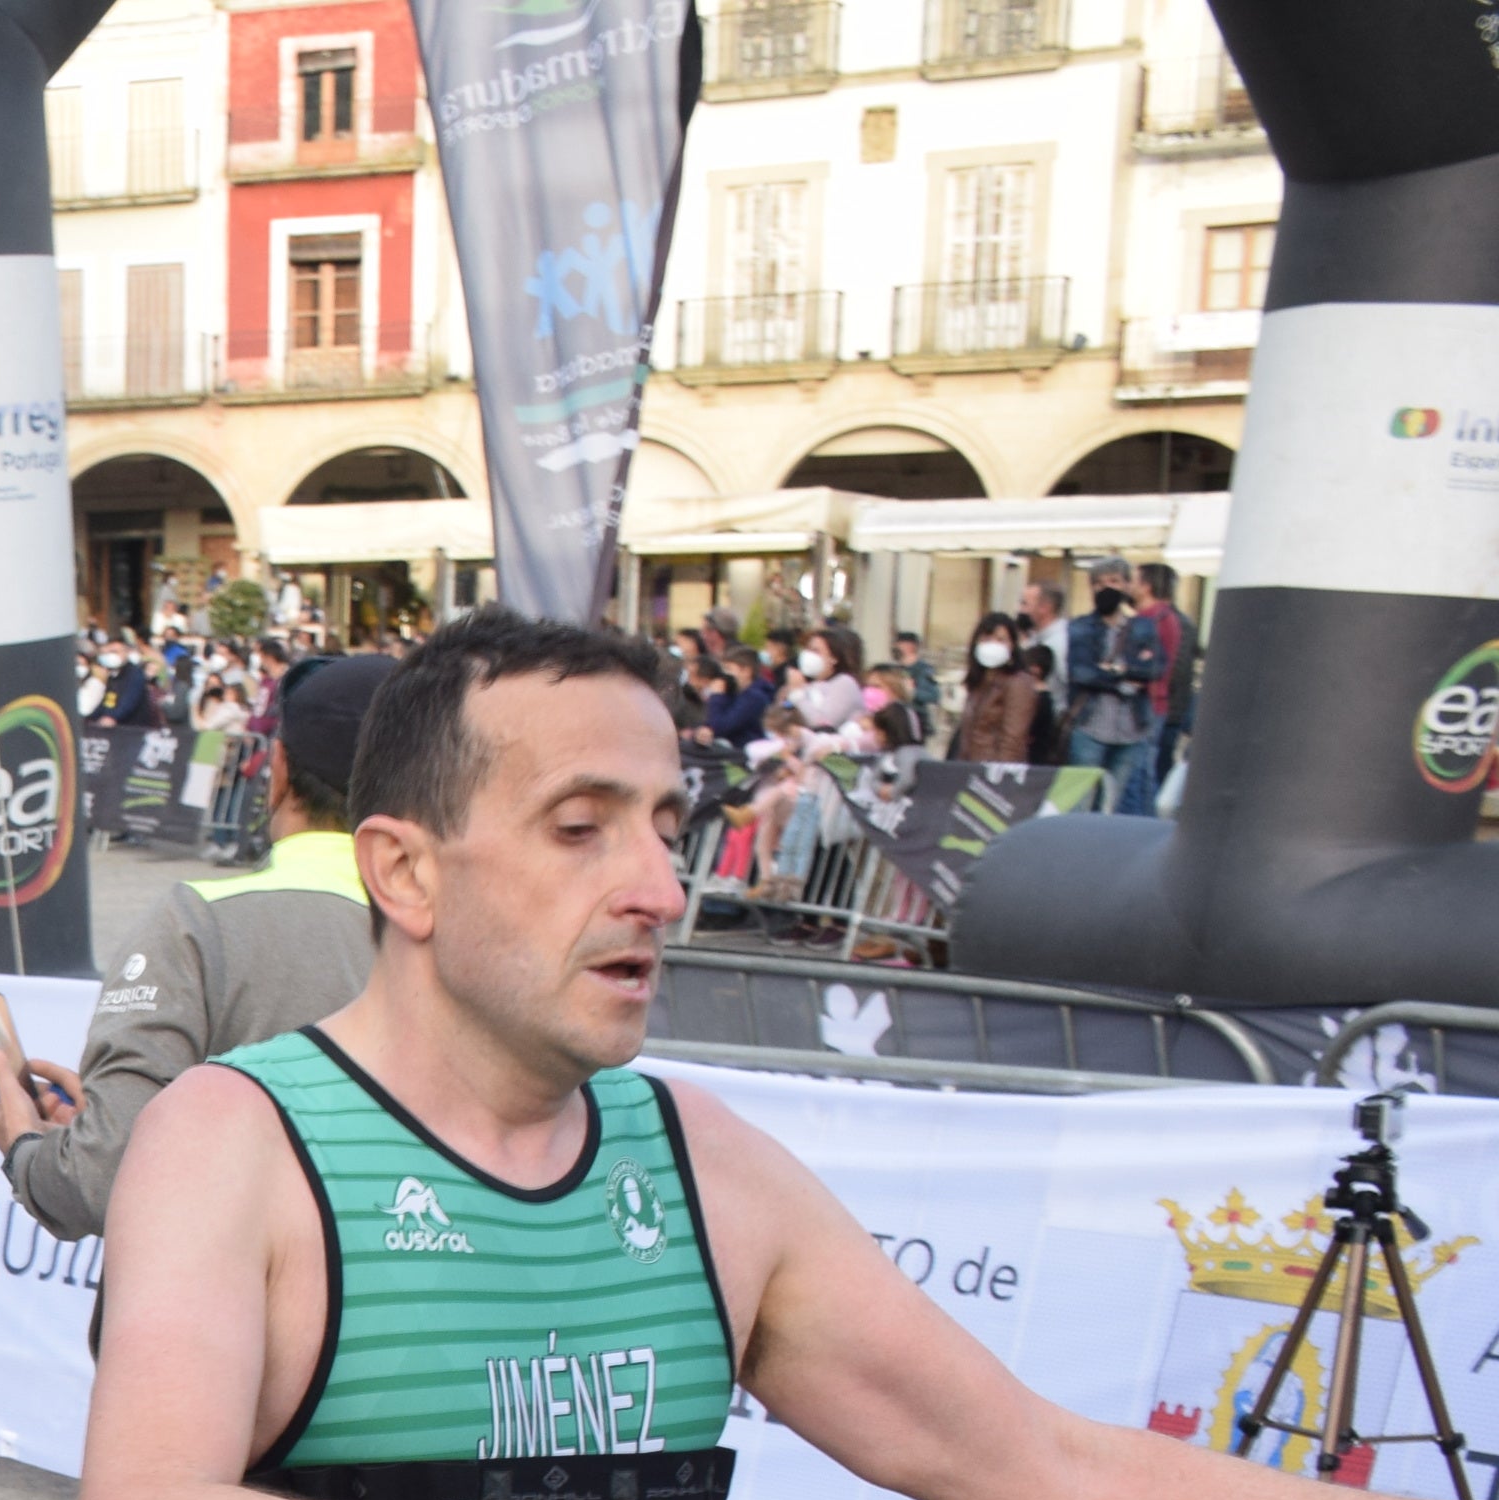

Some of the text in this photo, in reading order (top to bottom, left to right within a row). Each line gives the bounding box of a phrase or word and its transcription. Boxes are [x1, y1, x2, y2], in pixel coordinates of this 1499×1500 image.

[102, 986, 158, 1005] ZURICH
[384, 1230, 475, 1254] austral
[953, 1246, 1018, 1301] de
[478, 1329, 665, 1460] JIMÉNEZ
